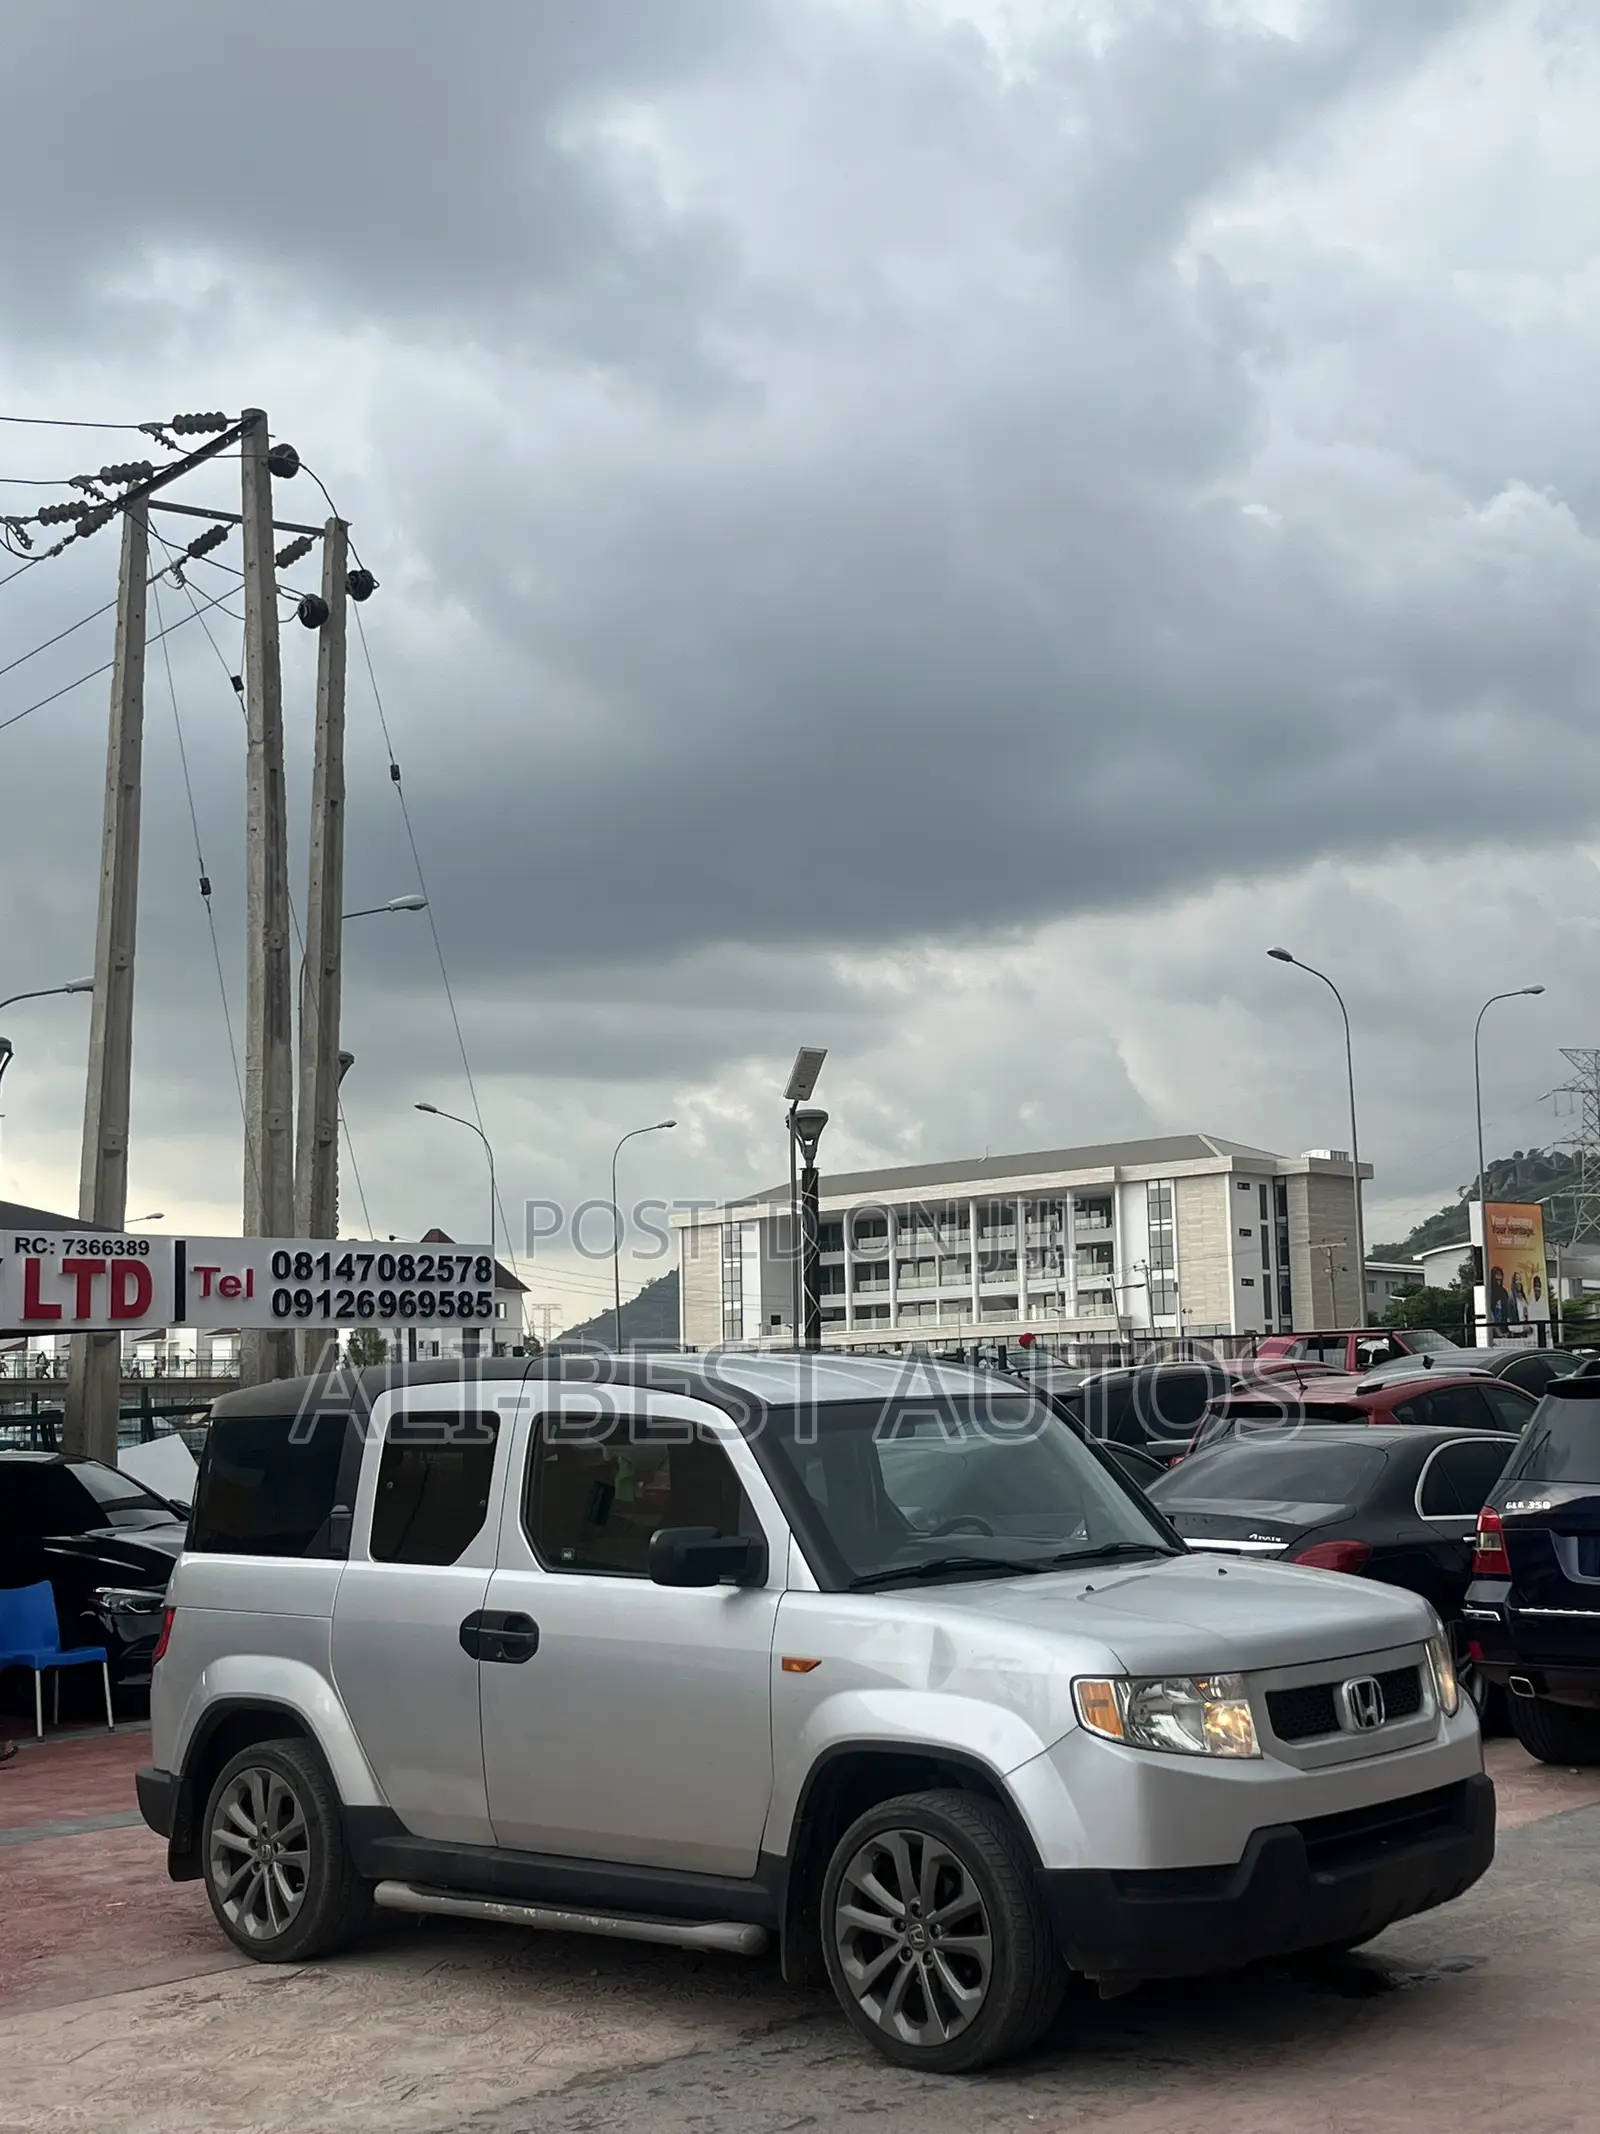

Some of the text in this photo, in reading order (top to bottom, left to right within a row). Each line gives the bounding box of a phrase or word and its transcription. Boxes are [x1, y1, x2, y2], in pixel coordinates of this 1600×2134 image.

[14, 1237, 150, 1256] RC: 7366389
[23, 1258, 153, 1320] LTD
[193, 1250, 492, 1298] Tel 08147082578
[272, 1287, 493, 1319] 09126969585
[1527, 1500, 1552, 1510] 350
